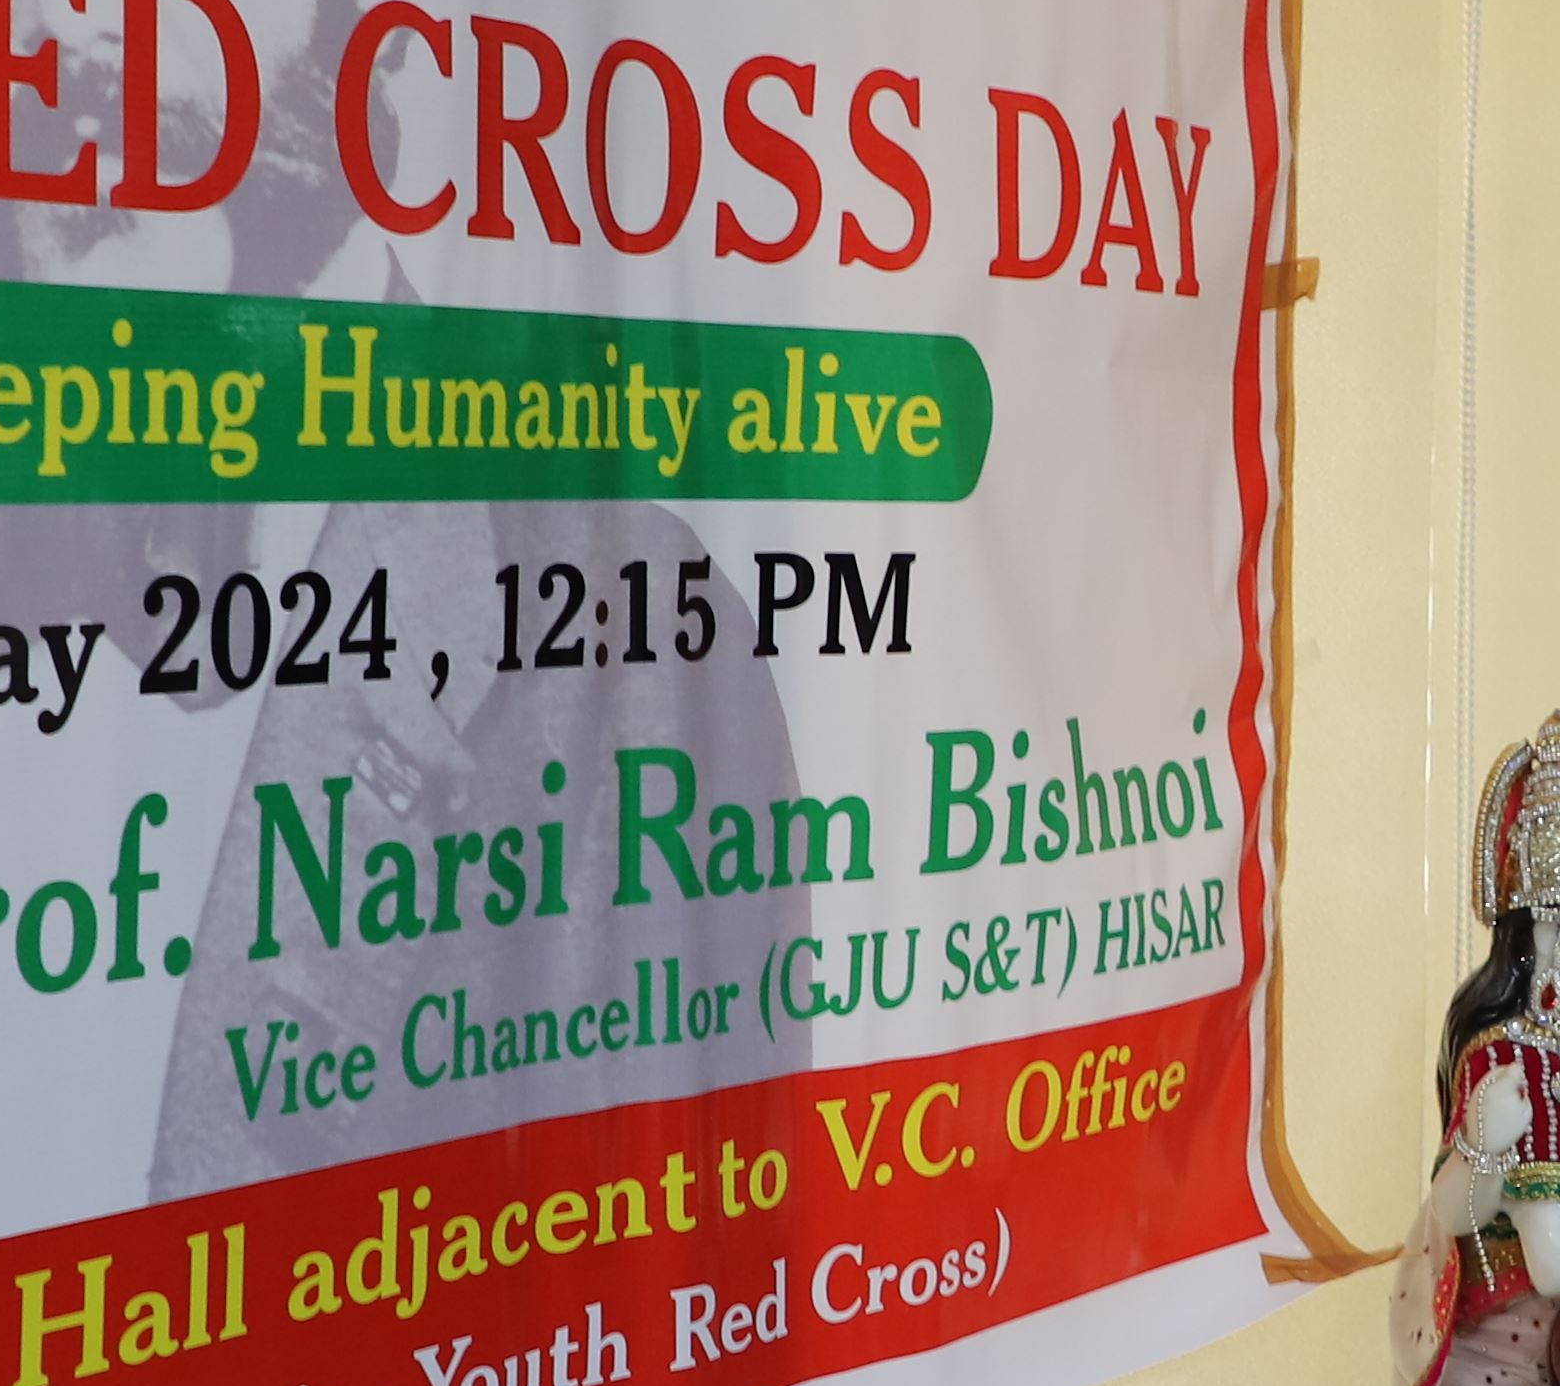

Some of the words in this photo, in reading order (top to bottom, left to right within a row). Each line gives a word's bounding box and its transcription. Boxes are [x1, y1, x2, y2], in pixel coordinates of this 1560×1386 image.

[333, 0, 932, 272] CROSS
[986, 85, 1212, 299] DAY
[296, 322, 702, 479] Humanity
[726, 349, 944, 460] alive
[138, 567, 398, 696] 2024
[493, 553, 718, 676] 12:15
[751, 550, 918, 661] PM
[248, 760, 570, 964] Narsi
[610, 745, 874, 908] Ram
[919, 708, 1224, 877] Bishnoi
[225, 1017, 376, 1124] Vice
[400, 959, 741, 1092] Chancellor
[758, 928, 920, 1047] (GJU
[939, 904, 1080, 1003] S&T)
[1091, 877, 1226, 977] HISAR
[287, 1149, 701, 1325] adjacent
[719, 1138, 789, 1222] to
[815, 1079, 976, 1195] V.C.
[1003, 1050, 1188, 1155] Office
[668, 1272, 789, 1377] Red
[809, 1206, 1014, 1330] Cross)
